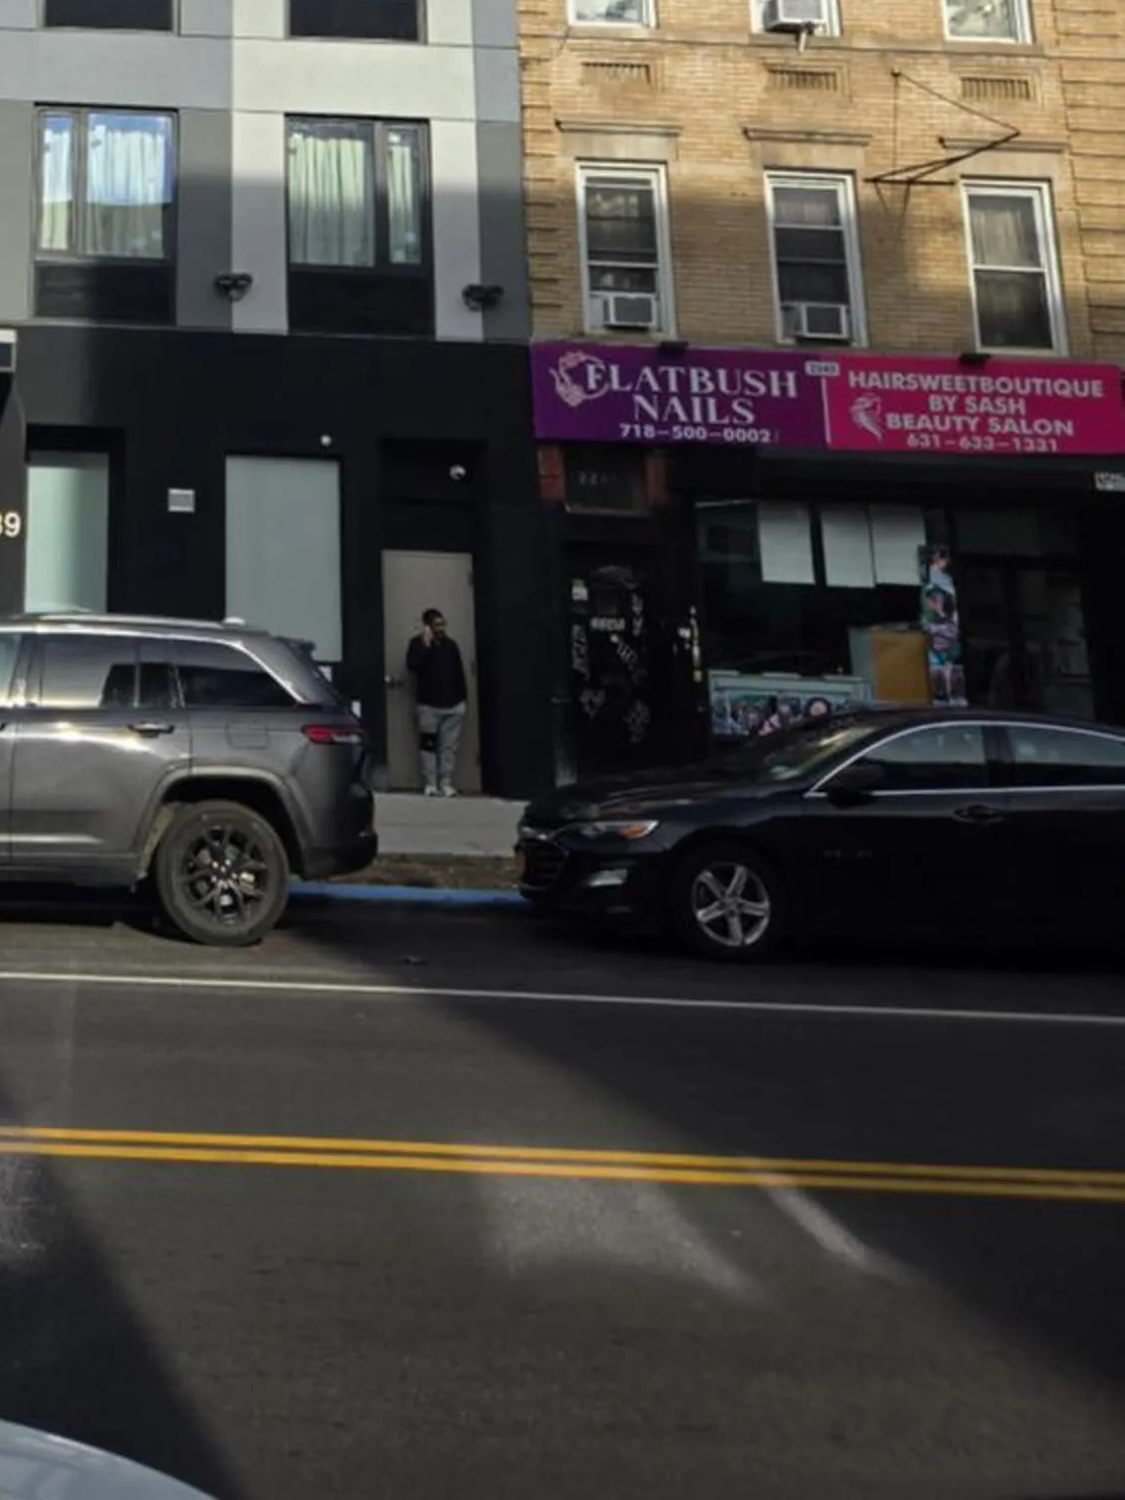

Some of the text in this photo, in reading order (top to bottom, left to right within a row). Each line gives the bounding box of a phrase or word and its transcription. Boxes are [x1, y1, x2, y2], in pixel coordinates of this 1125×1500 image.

[586, 363, 799, 398] FLATBUSH
[848, 370, 1104, 398] HAIRSWEETBOUTIQUE
[632, 394, 757, 425] NAILS
[928, 396, 1026, 416] BY SASH
[618, 423, 772, 443] 718-500-0002
[886, 413, 1075, 437] BEAUTY SALON
